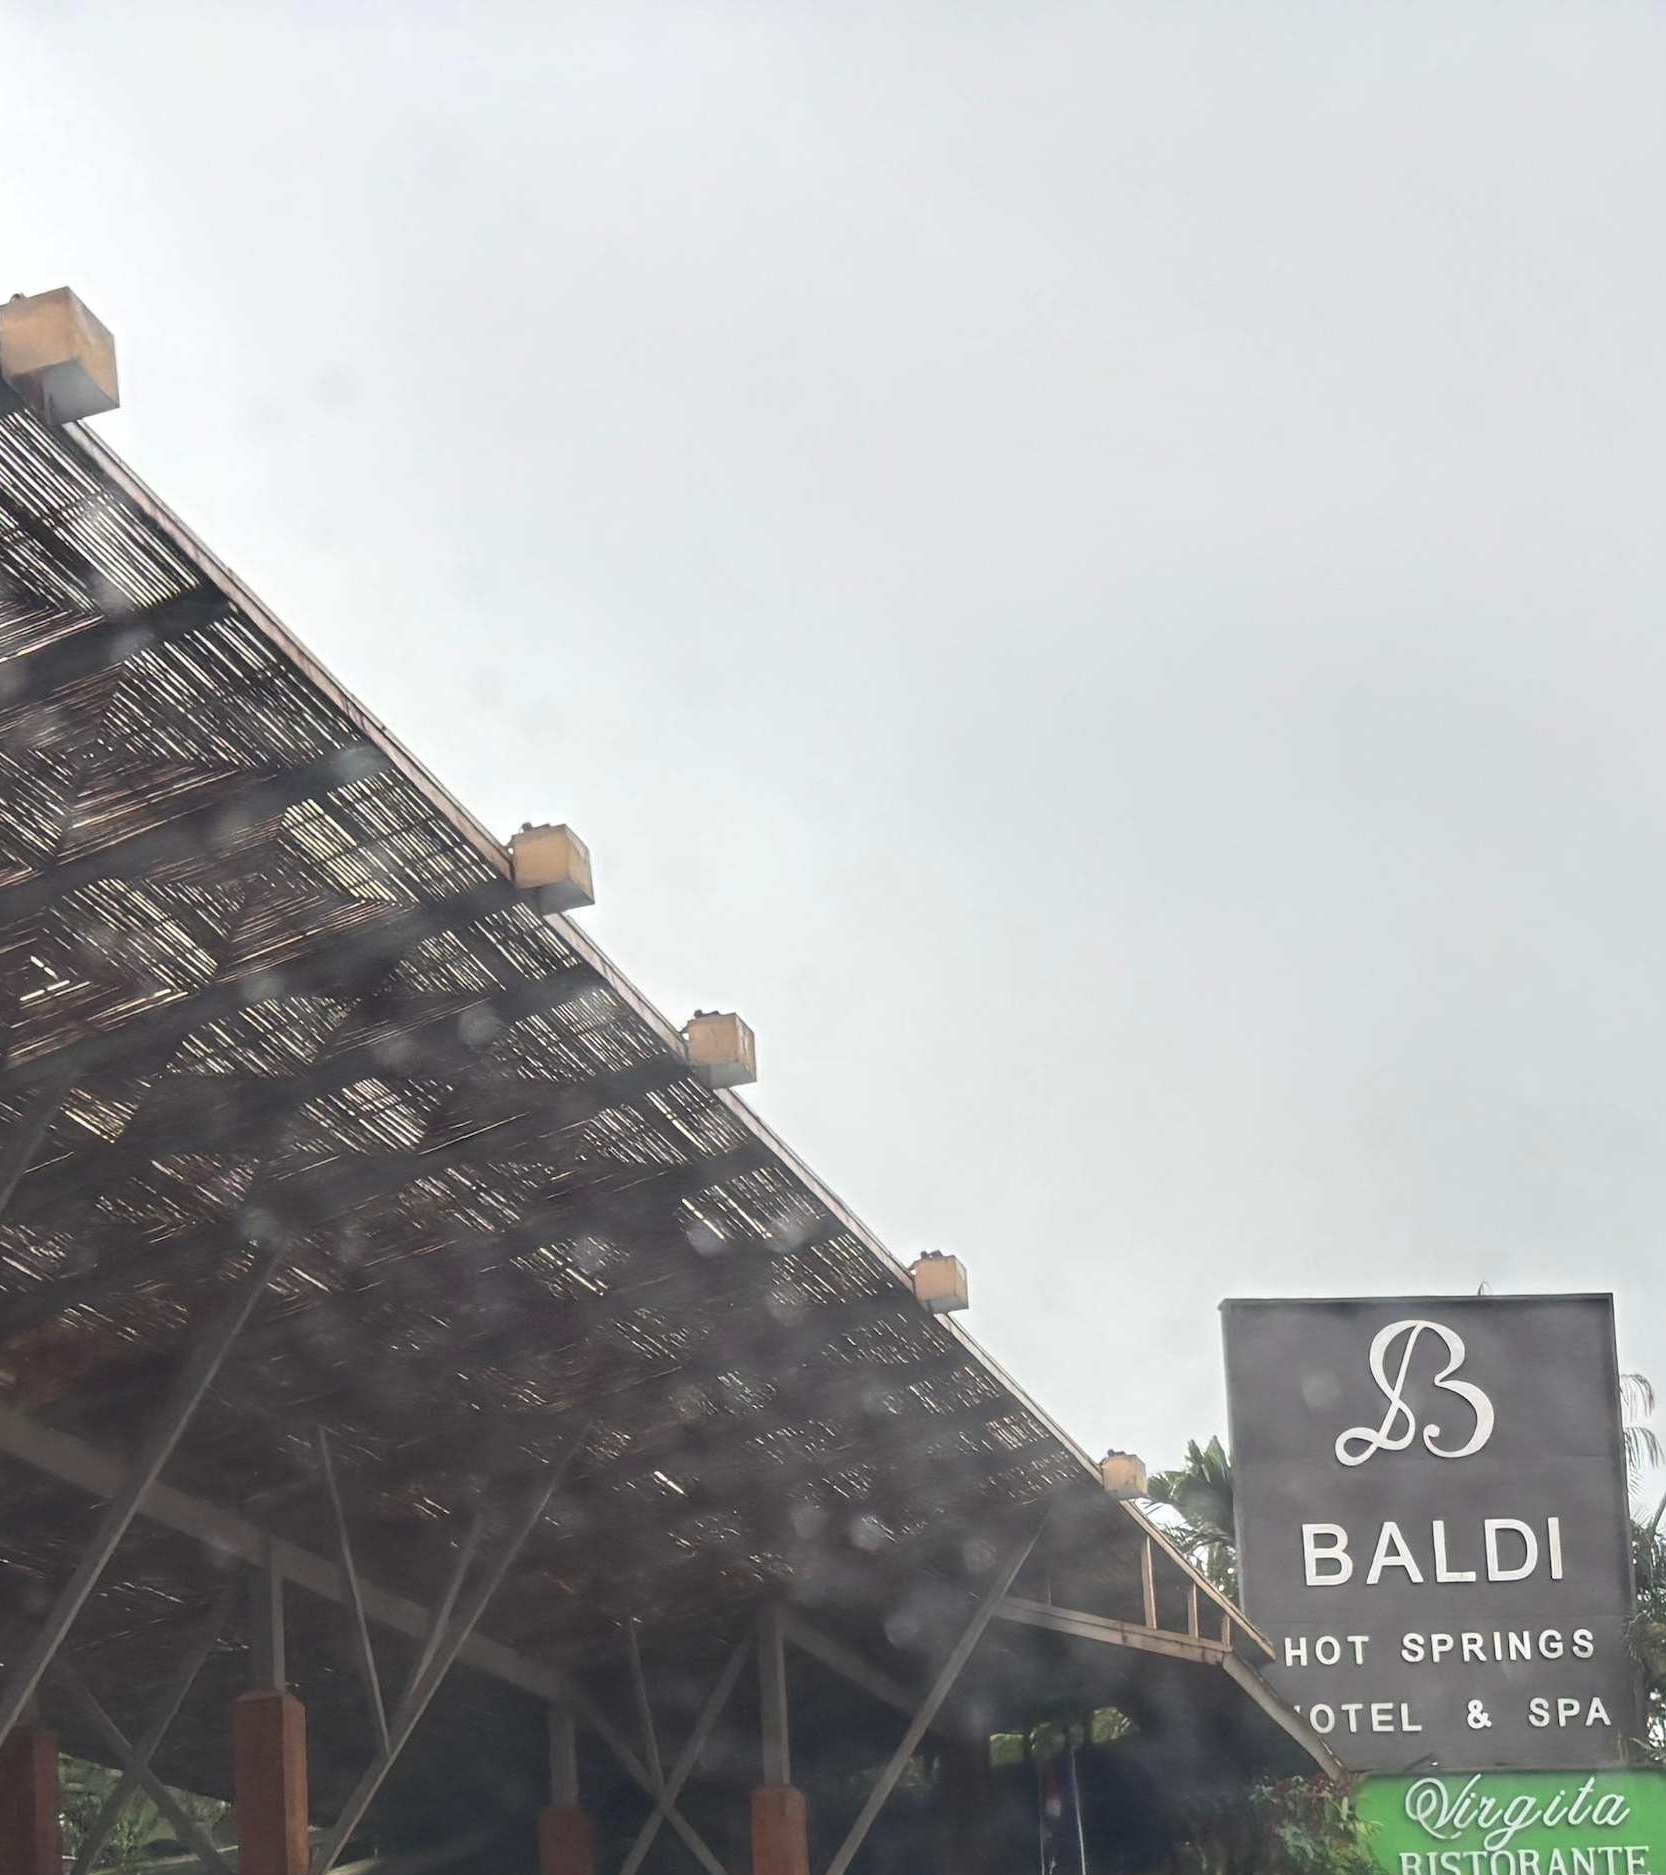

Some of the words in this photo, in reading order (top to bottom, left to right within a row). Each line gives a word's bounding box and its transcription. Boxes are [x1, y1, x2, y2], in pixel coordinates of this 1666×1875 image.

[1302, 1517, 1563, 1586] BALDI
[1284, 1635, 1369, 1667] HOT
[1401, 1628, 1594, 1663] SPRINGS
[1295, 1703, 1422, 1734] OTEL
[1467, 1699, 1492, 1729] &
[1528, 1697, 1611, 1727] SPA
[1404, 1773, 1632, 1852] Virgita
